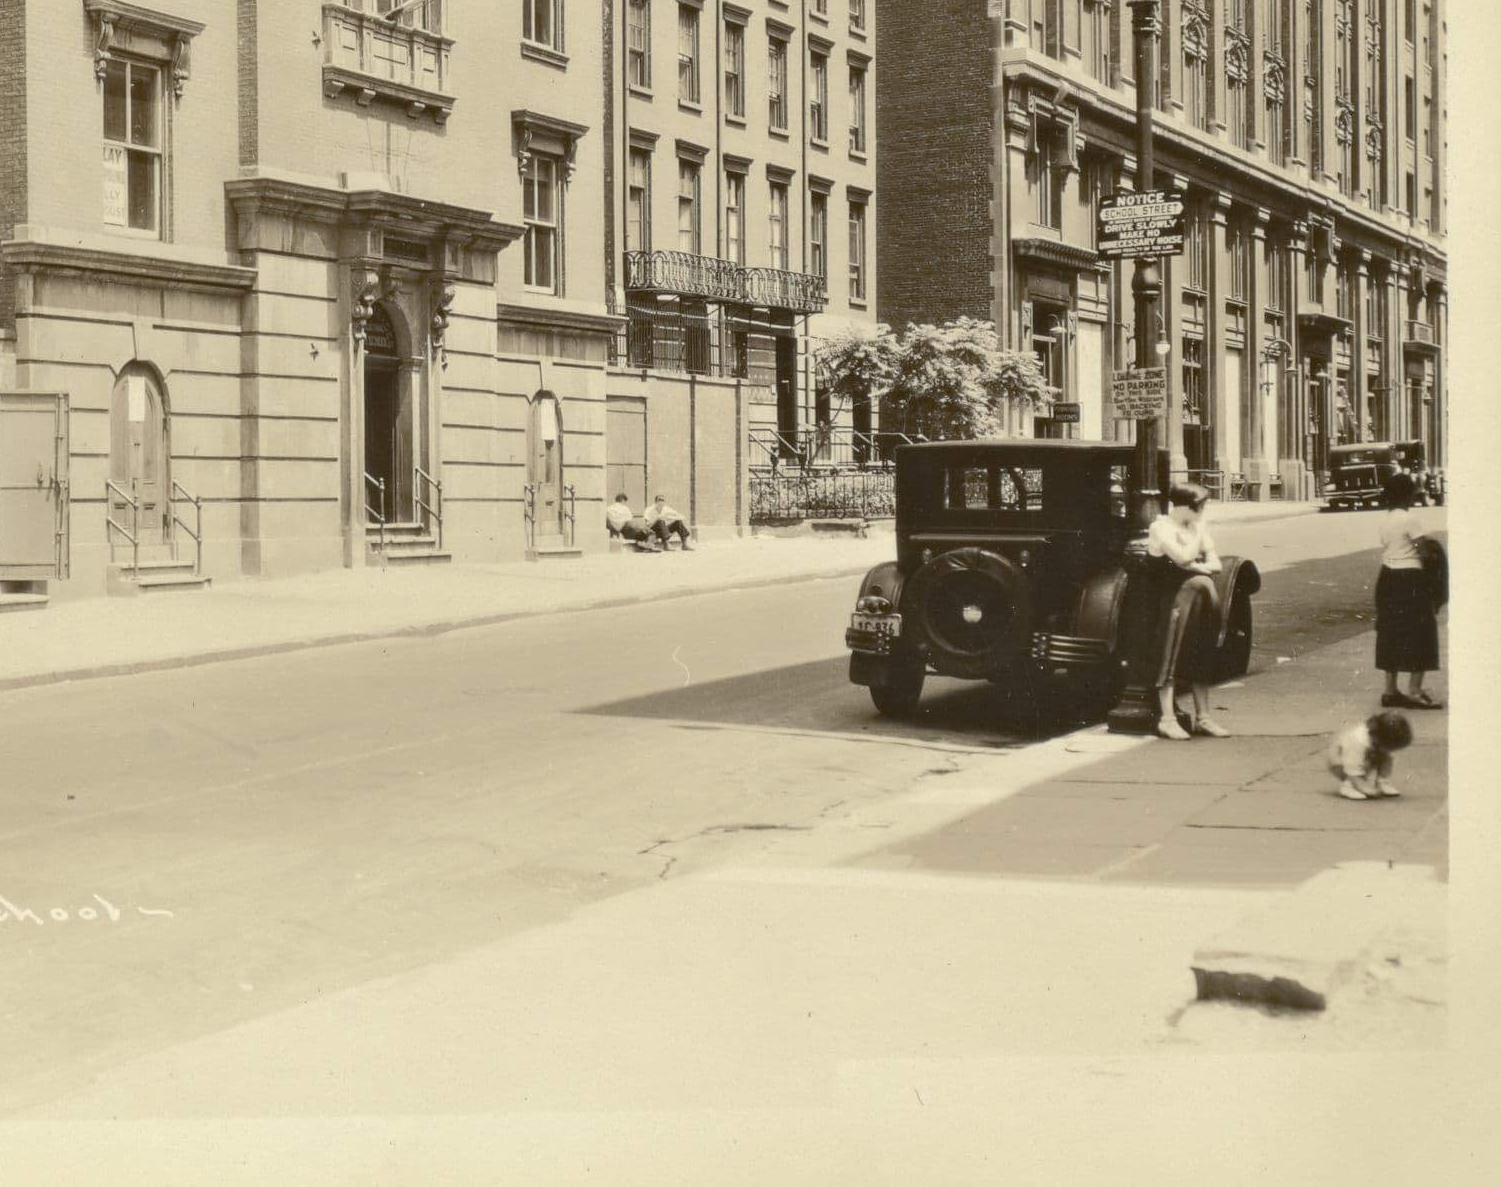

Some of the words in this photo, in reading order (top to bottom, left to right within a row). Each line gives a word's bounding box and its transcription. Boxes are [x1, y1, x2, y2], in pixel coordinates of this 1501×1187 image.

[1116, 192, 1165, 207] NOTICE
[1103, 207, 1138, 220] SCHOOL
[1142, 203, 1178, 216] STREET
[1104, 223, 1134, 233] DRIVE
[1135, 219, 1177, 230] SLOWLY
[1119, 230, 1145, 239] MAKE
[1146, 229, 1160, 237] NO
[1098, 237, 1156, 250] UNNECESSARY
[1157, 235, 1183, 245] NOISE
[1113, 382, 1125, 391] NO
[1127, 380, 1165, 391] PARKING
